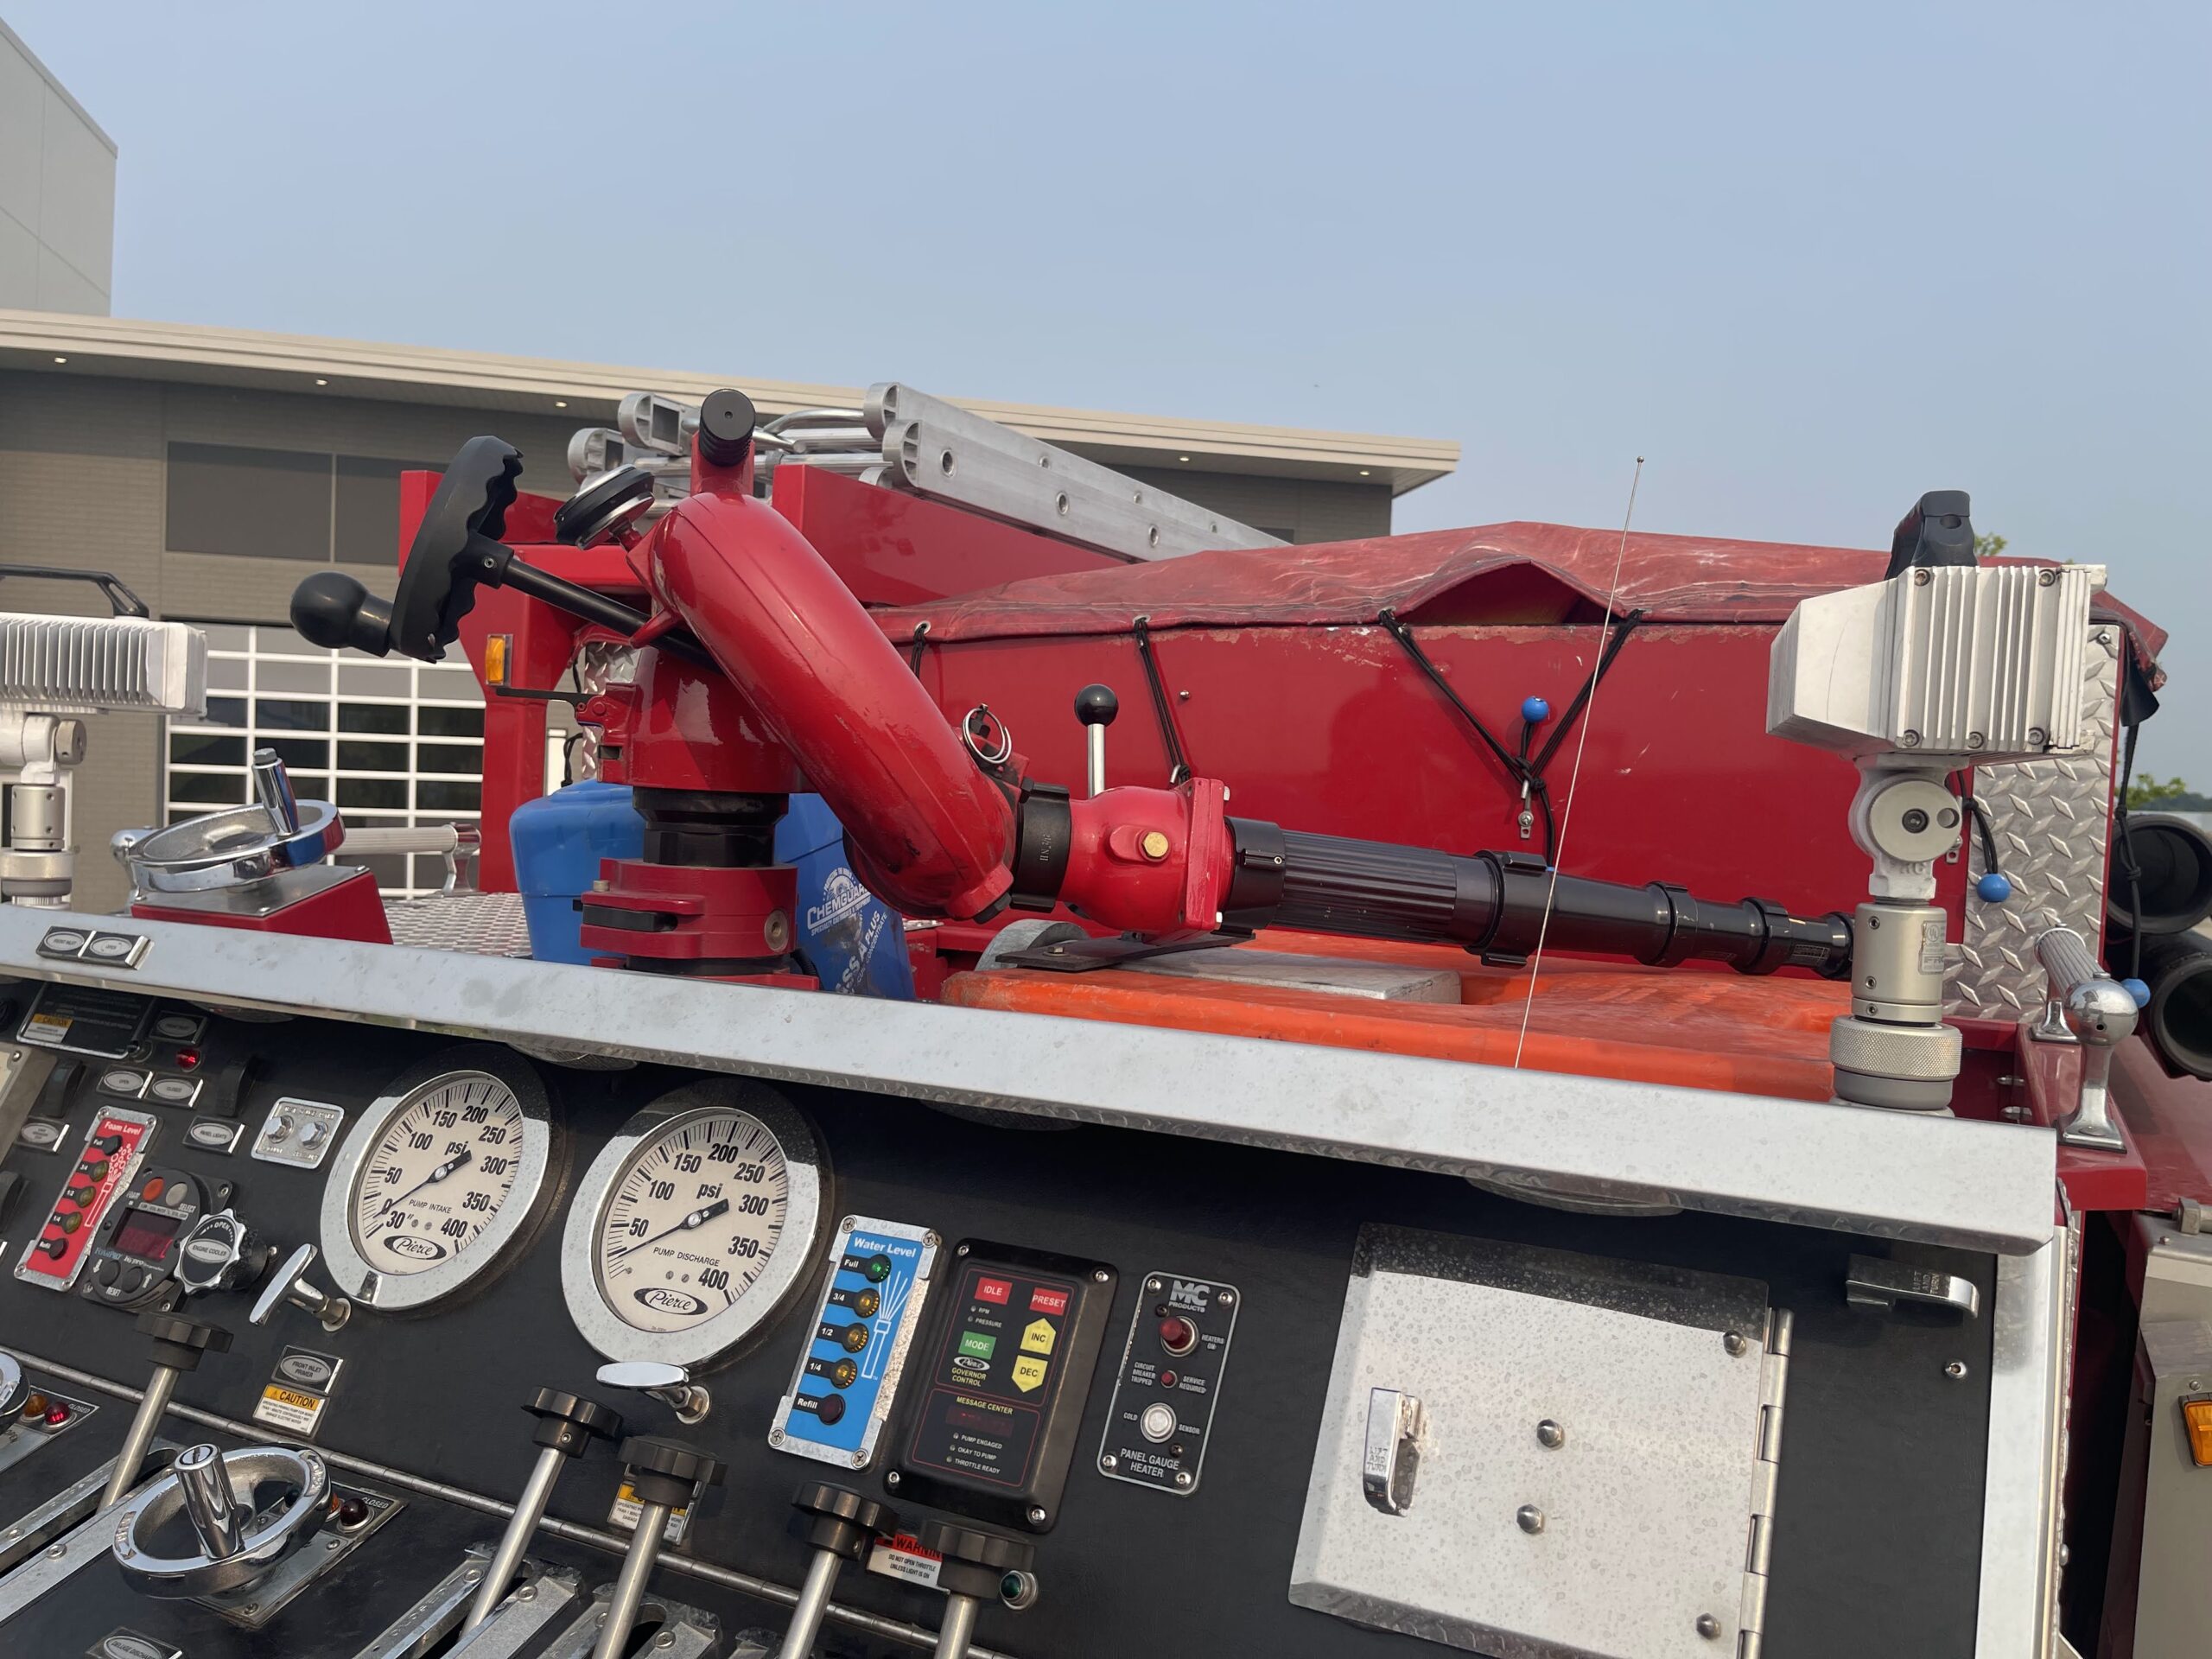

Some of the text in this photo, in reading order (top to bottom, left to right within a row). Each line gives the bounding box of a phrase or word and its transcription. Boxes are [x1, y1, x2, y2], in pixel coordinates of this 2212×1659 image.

[865, 910, 880, 945] PLUS
[432, 1110, 457, 1128] 150
[461, 1105, 488, 1124] 200
[105, 1122, 142, 1135] Foam Level
[479, 1125, 506, 1145] 250
[408, 1132, 433, 1150] 100
[444, 1140, 469, 1155] psi
[708, 1143, 739, 1164] 200
[480, 1156, 507, 1175] 300
[673, 1153, 702, 1173] 150
[385, 1167, 402, 1185] 50
[734, 1161, 766, 1184] 250
[648, 1180, 675, 1200] 100
[696, 1182, 723, 1199] psi
[409, 1199, 452, 1214] PUMP INTAKE
[462, 1192, 491, 1211] 350
[738, 1194, 770, 1216] 300
[213, 1221, 230, 1230] OPEN
[440, 1218, 468, 1238] 400
[629, 1218, 649, 1238] 50
[192, 1244, 227, 1256] ENGINE COOLER
[396, 1237, 433, 1255] Pierce
[728, 1236, 760, 1259] 350
[854, 1236, 917, 1258] Water Level
[653, 1246, 721, 1268] PUMP DISCHARGE
[844, 1259, 859, 1268] Full
[697, 1268, 729, 1291] 400
[833, 1293, 845, 1302] 3/4
[983, 1285, 1002, 1296] IDLE
[1170, 1280, 1211, 1306] MC
[651, 1290, 692, 1311] Pierce
[1032, 1294, 1066, 1308] PRESET
[1168, 1300, 1205, 1313] PRODUCTS
[975, 1318, 1002, 1328] PRESSURE
[822, 1328, 834, 1337] 1/2
[1031, 1332, 1046, 1343] INC
[1201, 1334, 1225, 1344] HEATERS
[965, 1338, 990, 1351] MODE
[293, 1361, 308, 1370] FRONT
[295, 1369, 314, 1377] PRIMER
[810, 1363, 822, 1372] 1/4
[1020, 1367, 1039, 1377] DEC
[1134, 1362, 1155, 1371] CIRCUIT
[951, 1367, 987, 1380] GOVERNOR
[951, 1375, 982, 1387] CONTROL
[1131, 1376, 1153, 1386] TRIPPED
[1132, 1369, 1156, 1379] BREAKER
[1183, 1376, 1205, 1386] SERVICE
[279, 1391, 315, 1408] CAUTION
[798, 1398, 818, 1409] Refill
[956, 1395, 1014, 1414] MESSAGE CENTER
[68, 1403, 91, 1414] CLOSED
[1123, 1412, 1138, 1421] COLD
[1178, 1424, 1200, 1434] SENSOR
[961, 1434, 1002, 1449] PUMP ENGAGED
[957, 1446, 973, 1455] OKAY
[955, 1459, 1001, 1474] THROTTLE READY
[1120, 1448, 1180, 1470] PANEL GAUGE
[1130, 1461, 1164, 1478] HEATER
[361, 1497, 389, 1510] CLOSED
[896, 1535, 942, 1559] WARNIN
[916, 1561, 936, 1572] THROTTLE
